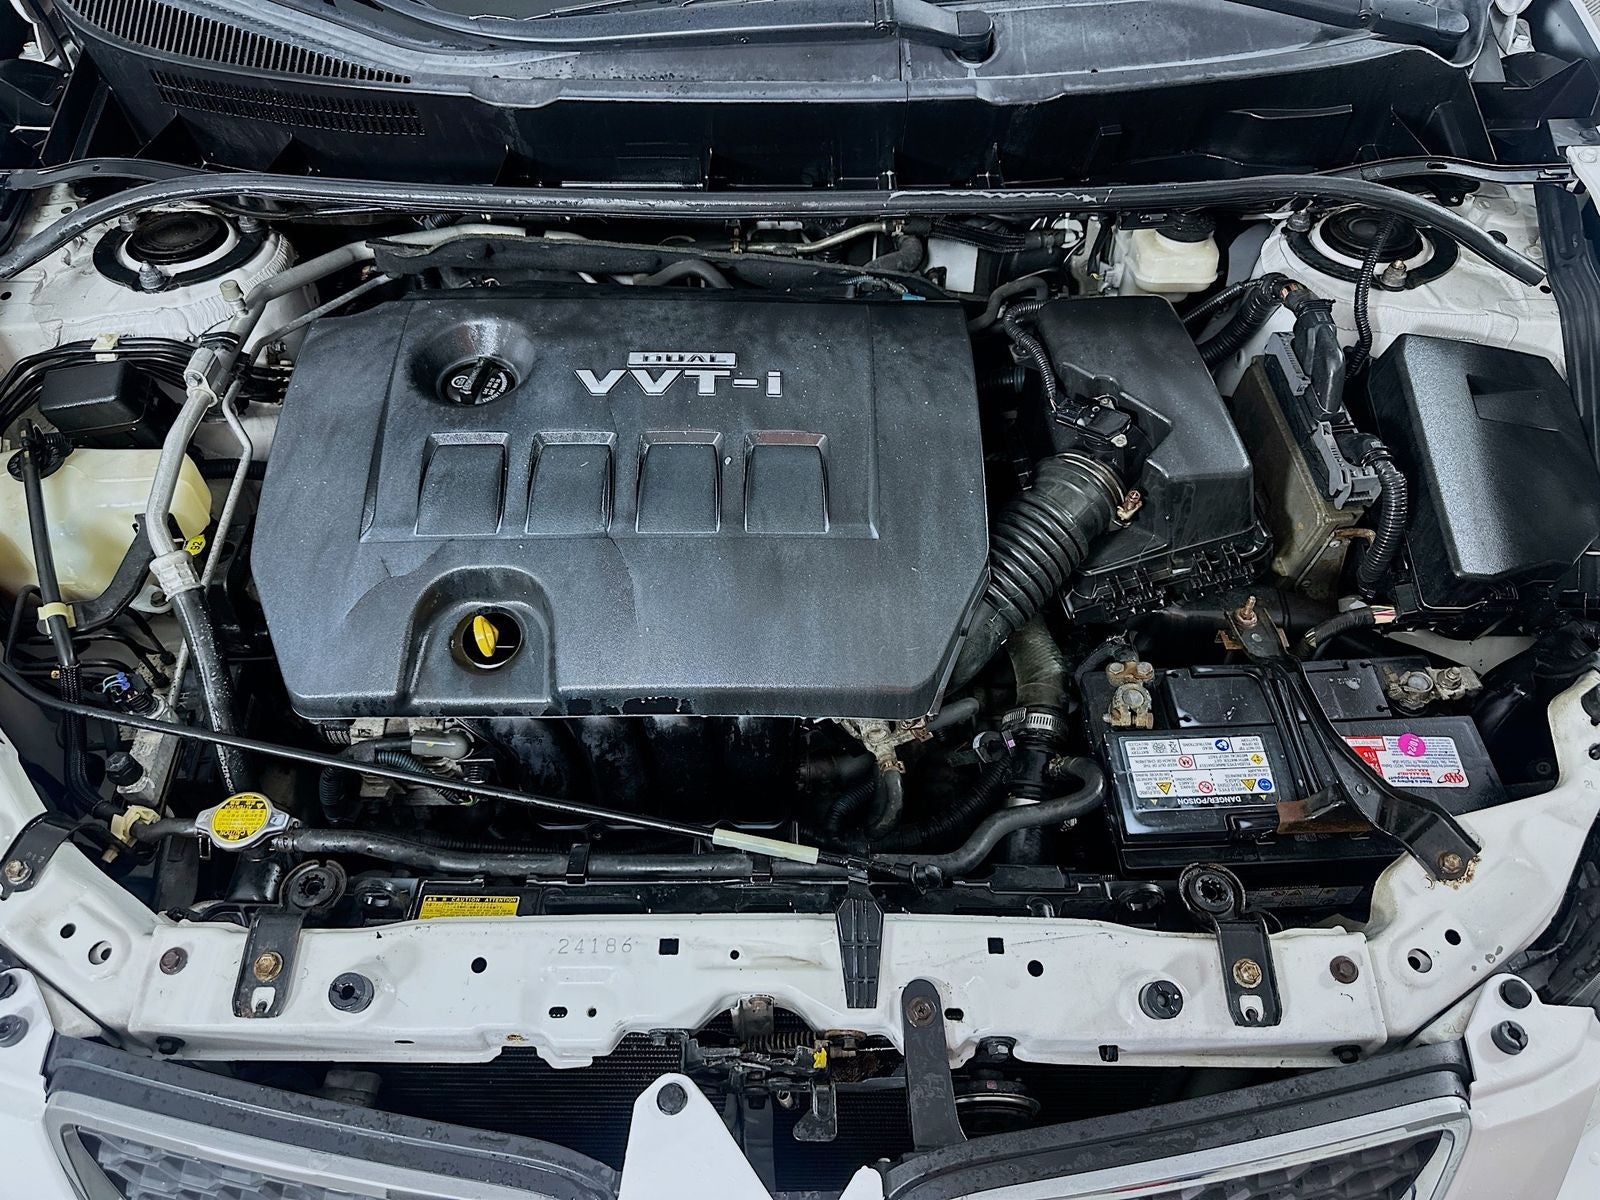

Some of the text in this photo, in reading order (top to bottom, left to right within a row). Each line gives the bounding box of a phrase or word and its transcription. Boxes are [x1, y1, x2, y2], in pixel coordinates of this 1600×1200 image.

[574, 369, 782, 396] VVT-i
[1407, 738, 1419, 755] 10/24
[1445, 773, 1463, 783] AAA
[1177, 796, 1242, 804] DANGER/POISON
[558, 938, 632, 954] 24186
